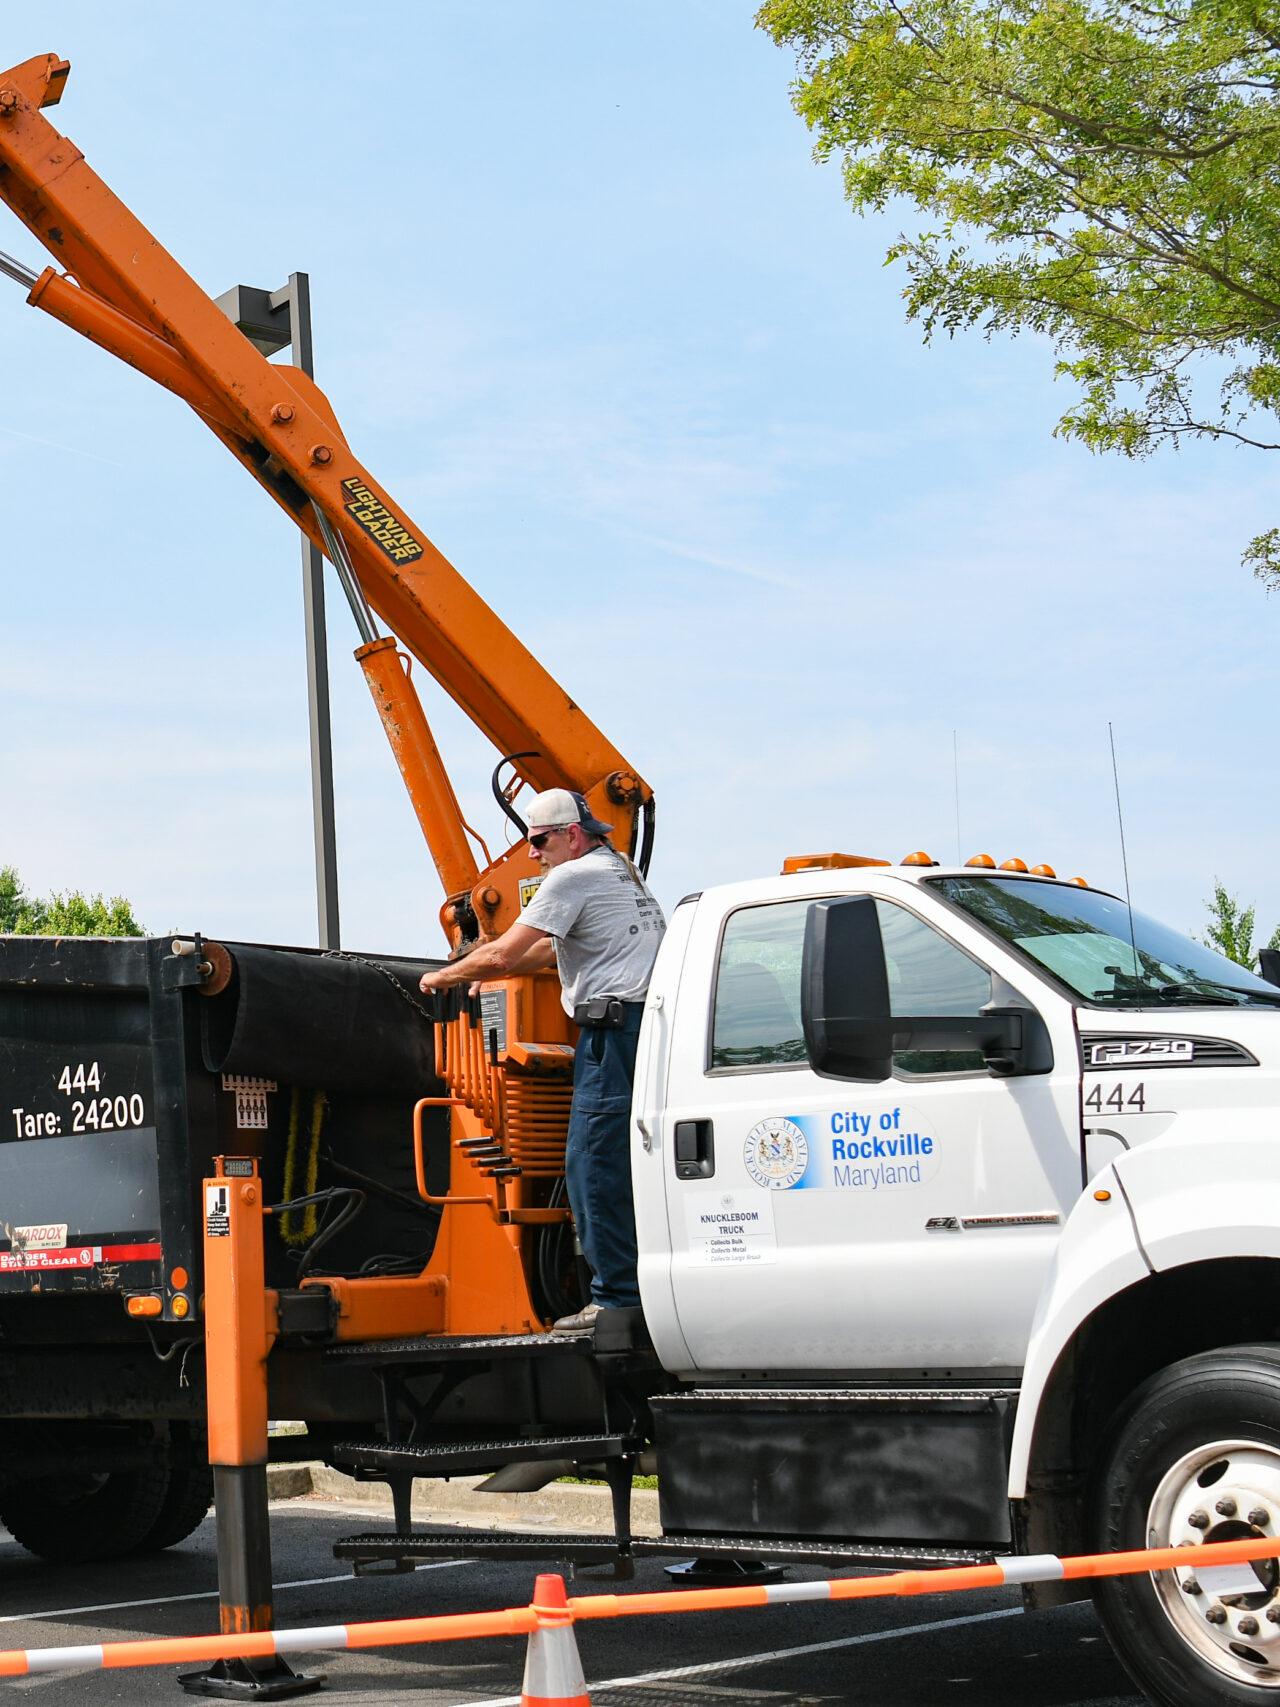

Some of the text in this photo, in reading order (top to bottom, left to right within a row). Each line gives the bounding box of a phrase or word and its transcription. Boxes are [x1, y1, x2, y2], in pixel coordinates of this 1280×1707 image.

[344, 478, 423, 555] LIGHTNING
[348, 502, 409, 560] LOADER
[58, 1061, 101, 1096] 444
[1084, 1082, 1146, 1113] 444
[12, 1093, 144, 1138] Tare: 24200
[831, 1107, 901, 1137] City of
[831, 1133, 933, 1160] Rockville
[833, 1160, 921, 1190] Maryland
[700, 1212, 759, 1223] KNUCKLEBOOM
[719, 1225, 744, 1234] TRUCK
[0, 1252, 47, 1262] DANGER
[0, 1257, 78, 1268] STAND CLEAR
